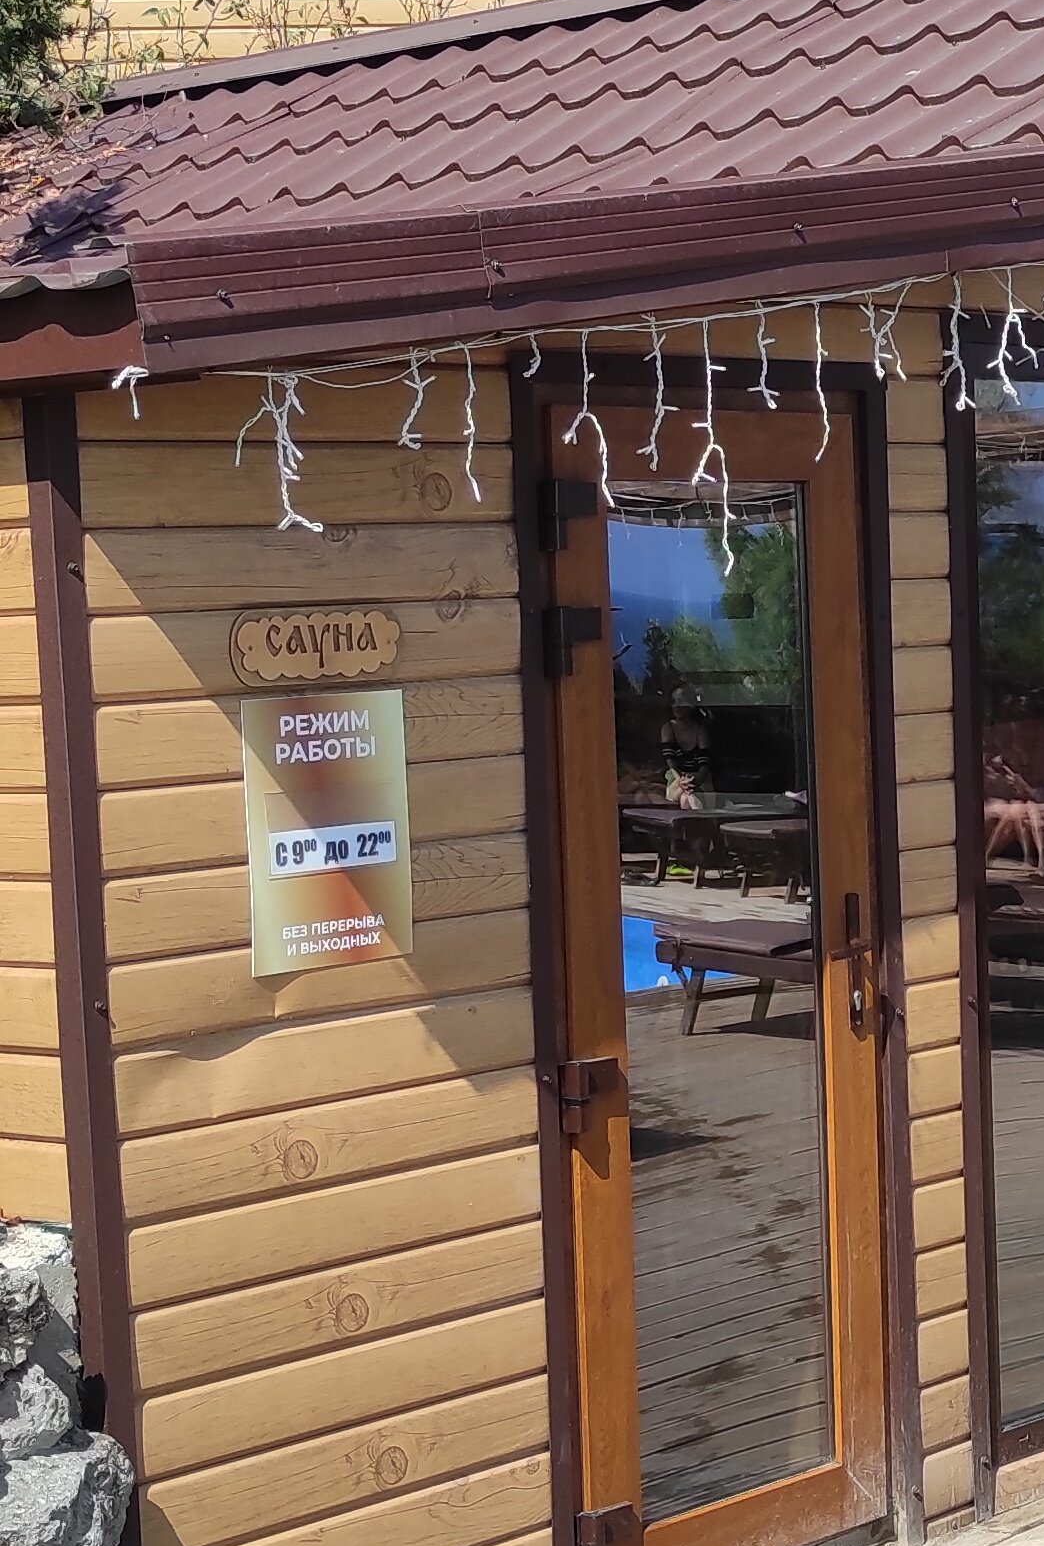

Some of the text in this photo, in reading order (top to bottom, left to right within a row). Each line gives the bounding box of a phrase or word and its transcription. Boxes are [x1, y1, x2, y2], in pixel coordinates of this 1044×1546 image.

[280, 709, 370, 738] РЕЖИМ
[275, 735, 376, 765] РАБОТЫ
[282, 914, 385, 940] БЕЗ ПЕРЕРЫВА
[287, 931, 381, 957] И ВЫХОДНЫХ
